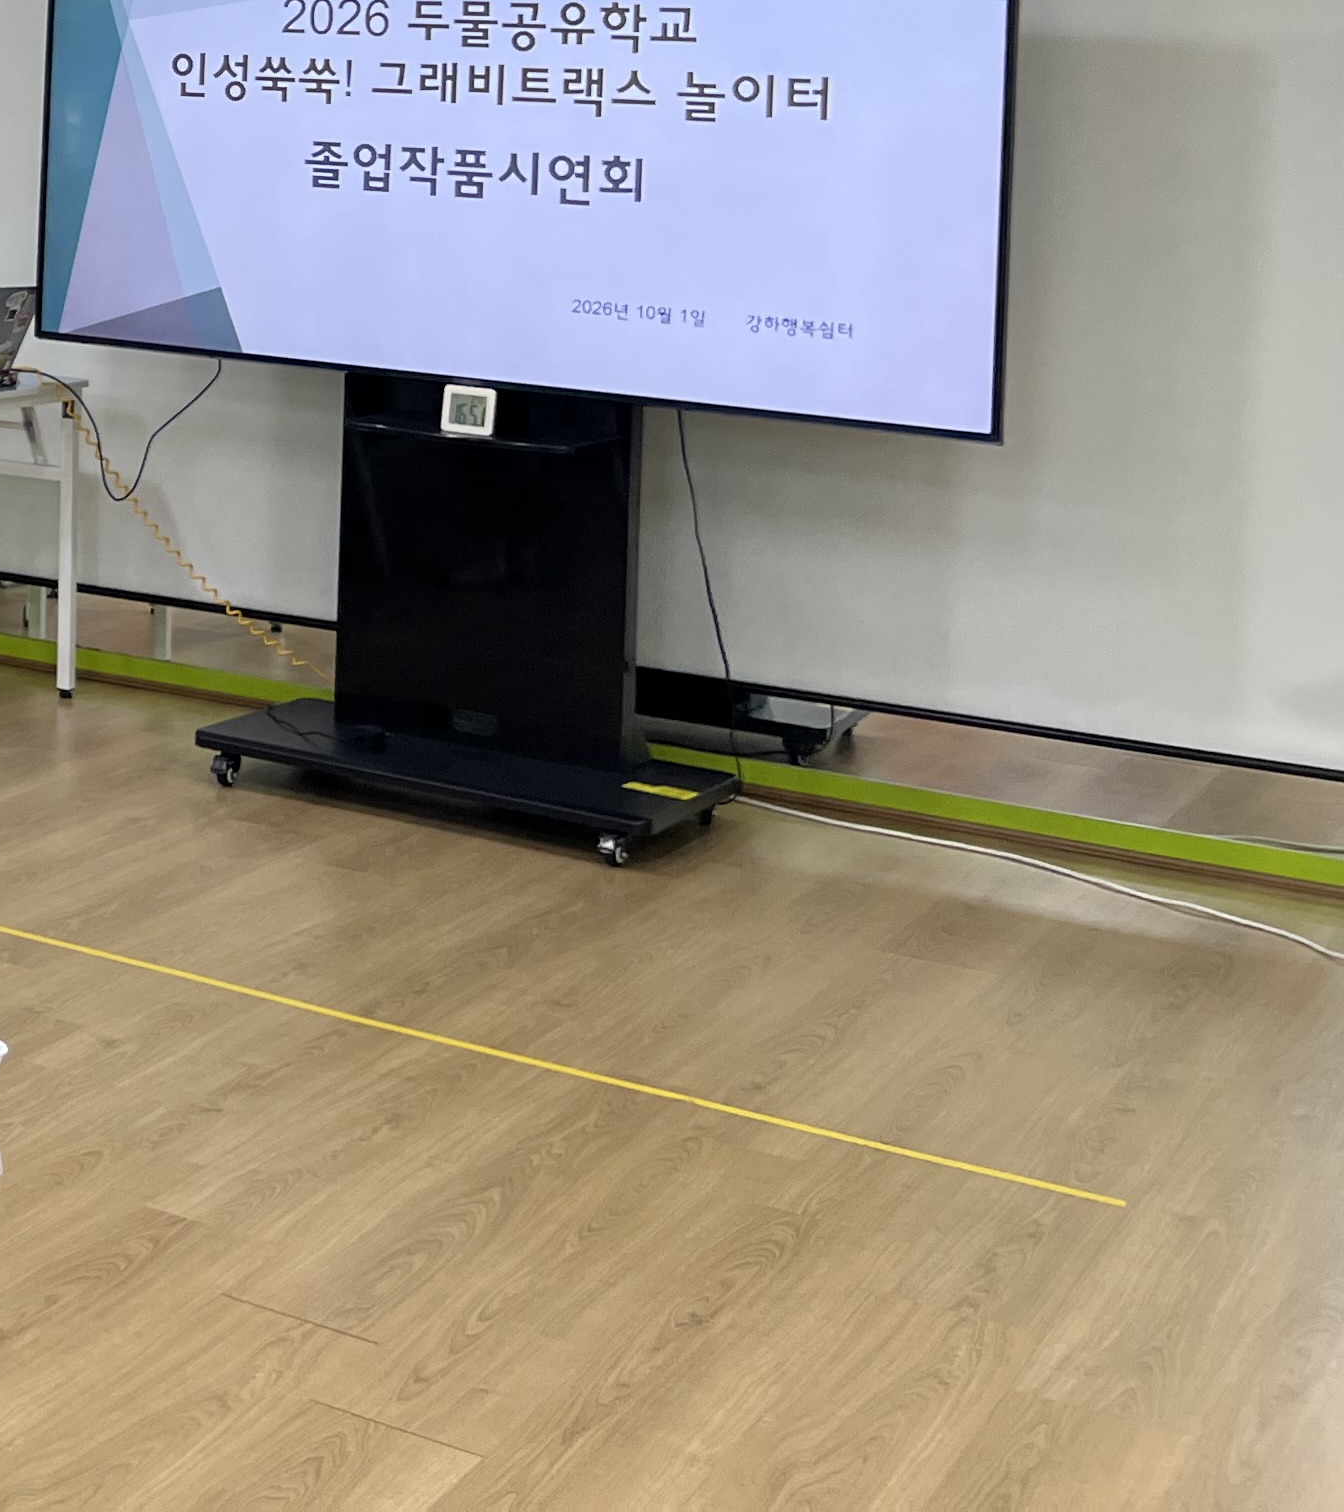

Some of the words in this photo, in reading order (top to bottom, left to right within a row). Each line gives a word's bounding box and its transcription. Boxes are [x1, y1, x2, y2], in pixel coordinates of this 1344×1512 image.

[407, 0, 697, 53] 두물공유학교
[171, 51, 353, 105] 인성쑥쑥!
[371, 62, 656, 117] 그래비트랙스
[676, 71, 829, 122] 놀이터
[304, 140, 644, 206] 졸업작품시연회
[571, 299, 629, 321] 2026년
[637, 304, 672, 325] 10월
[680, 308, 706, 328] 1일
[746, 314, 853, 340] 강하행복쉼터
